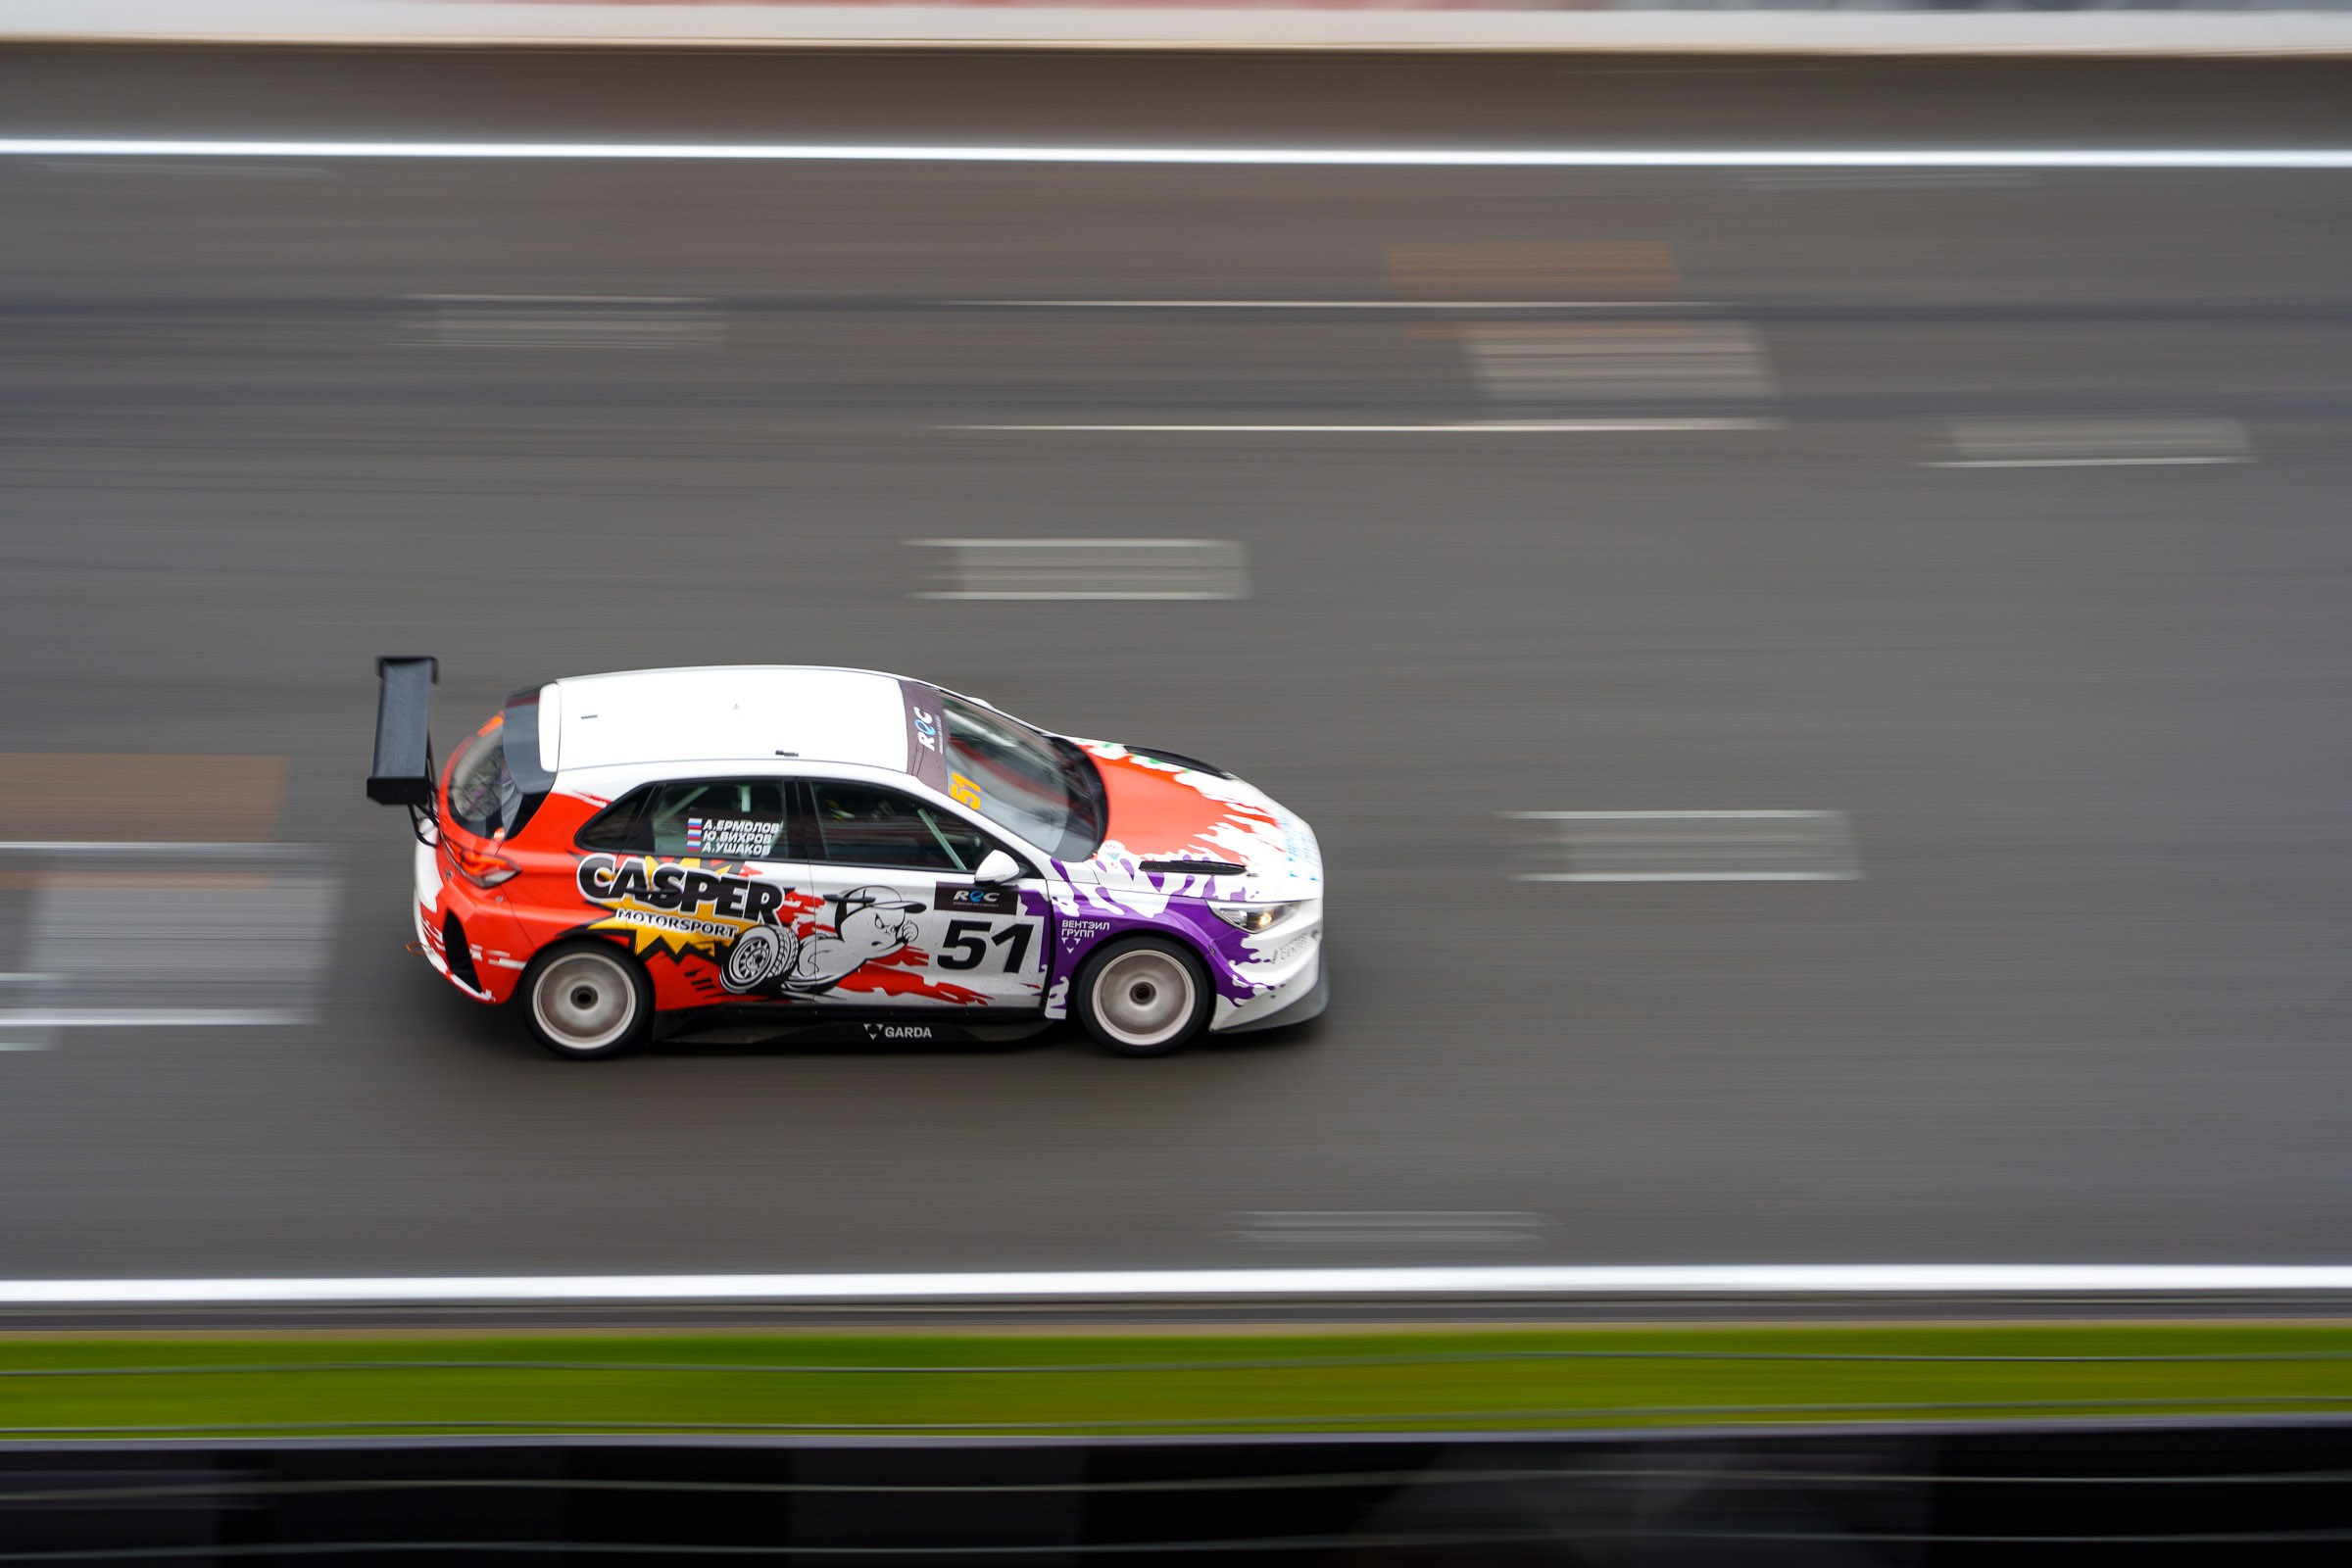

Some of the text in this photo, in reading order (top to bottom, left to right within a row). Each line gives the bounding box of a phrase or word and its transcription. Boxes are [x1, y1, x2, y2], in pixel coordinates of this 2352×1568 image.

[951, 771, 982, 810] 51
[703, 819, 780, 834] А.ЕРМОЛОВ
[703, 830, 772, 845] Ю.ВИХРОВ
[702, 842, 771, 856] А.УШАКОВ
[576, 853, 786, 928] CASPER
[615, 907, 740, 939] MOTORSPORT
[1061, 919, 1110, 931] ВЕНТЭИЛ
[1061, 929, 1095, 939] ГРУПП
[937, 919, 1035, 974] 51
[884, 1026, 933, 1039] GARDA
